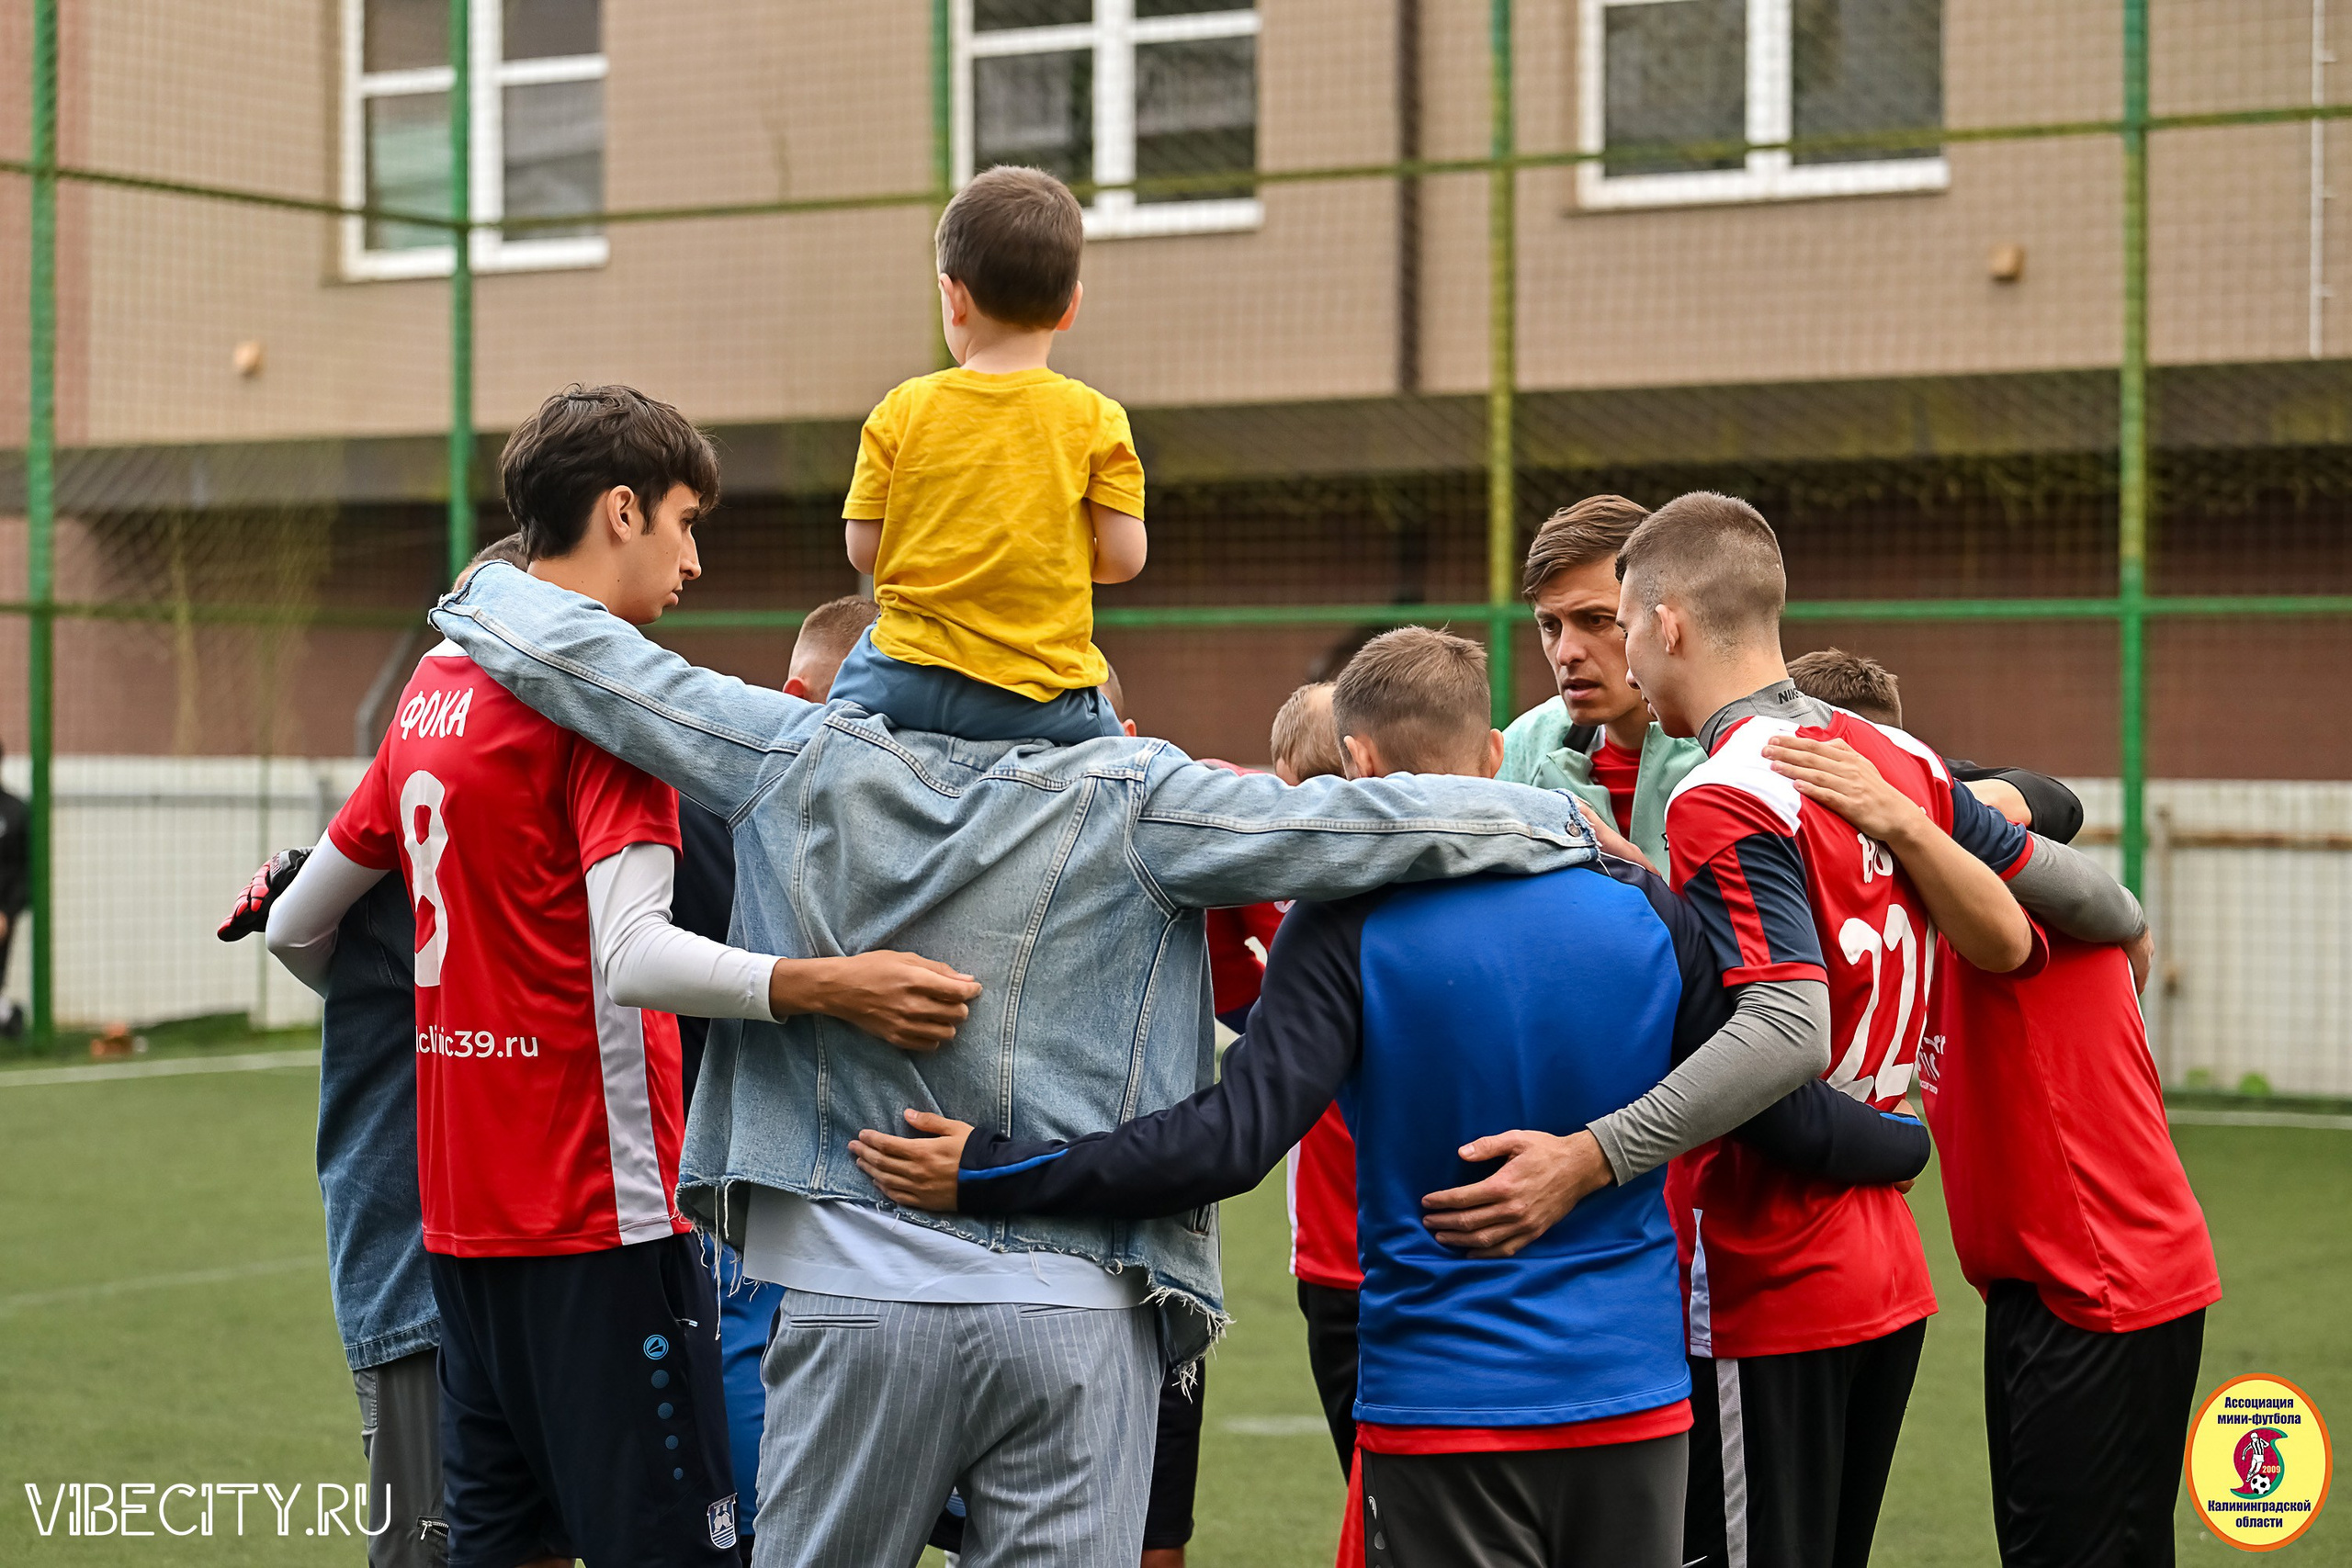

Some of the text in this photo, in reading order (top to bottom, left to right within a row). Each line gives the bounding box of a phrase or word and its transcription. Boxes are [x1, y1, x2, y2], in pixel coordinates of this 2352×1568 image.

[400, 687, 474, 740] ФОКА
[1778, 688, 1802, 705] NIK
[400, 769, 449, 987] 8
